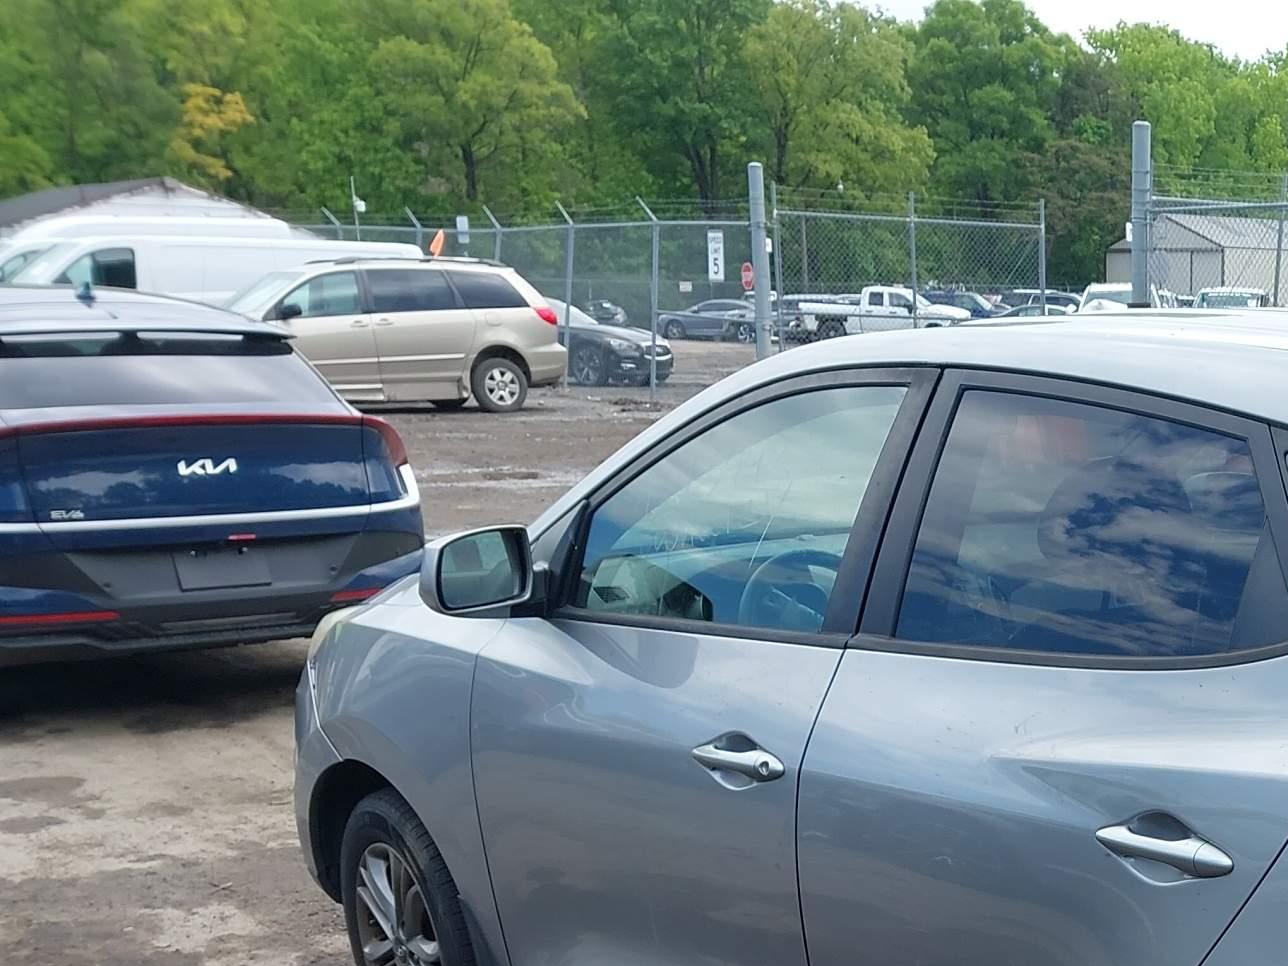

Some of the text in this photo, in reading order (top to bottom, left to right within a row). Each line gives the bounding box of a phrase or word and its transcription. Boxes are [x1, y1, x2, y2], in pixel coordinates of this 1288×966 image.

[713, 257, 720, 274] 5
[177, 457, 237, 476] KIA
[50, 508, 85, 520] EV6
